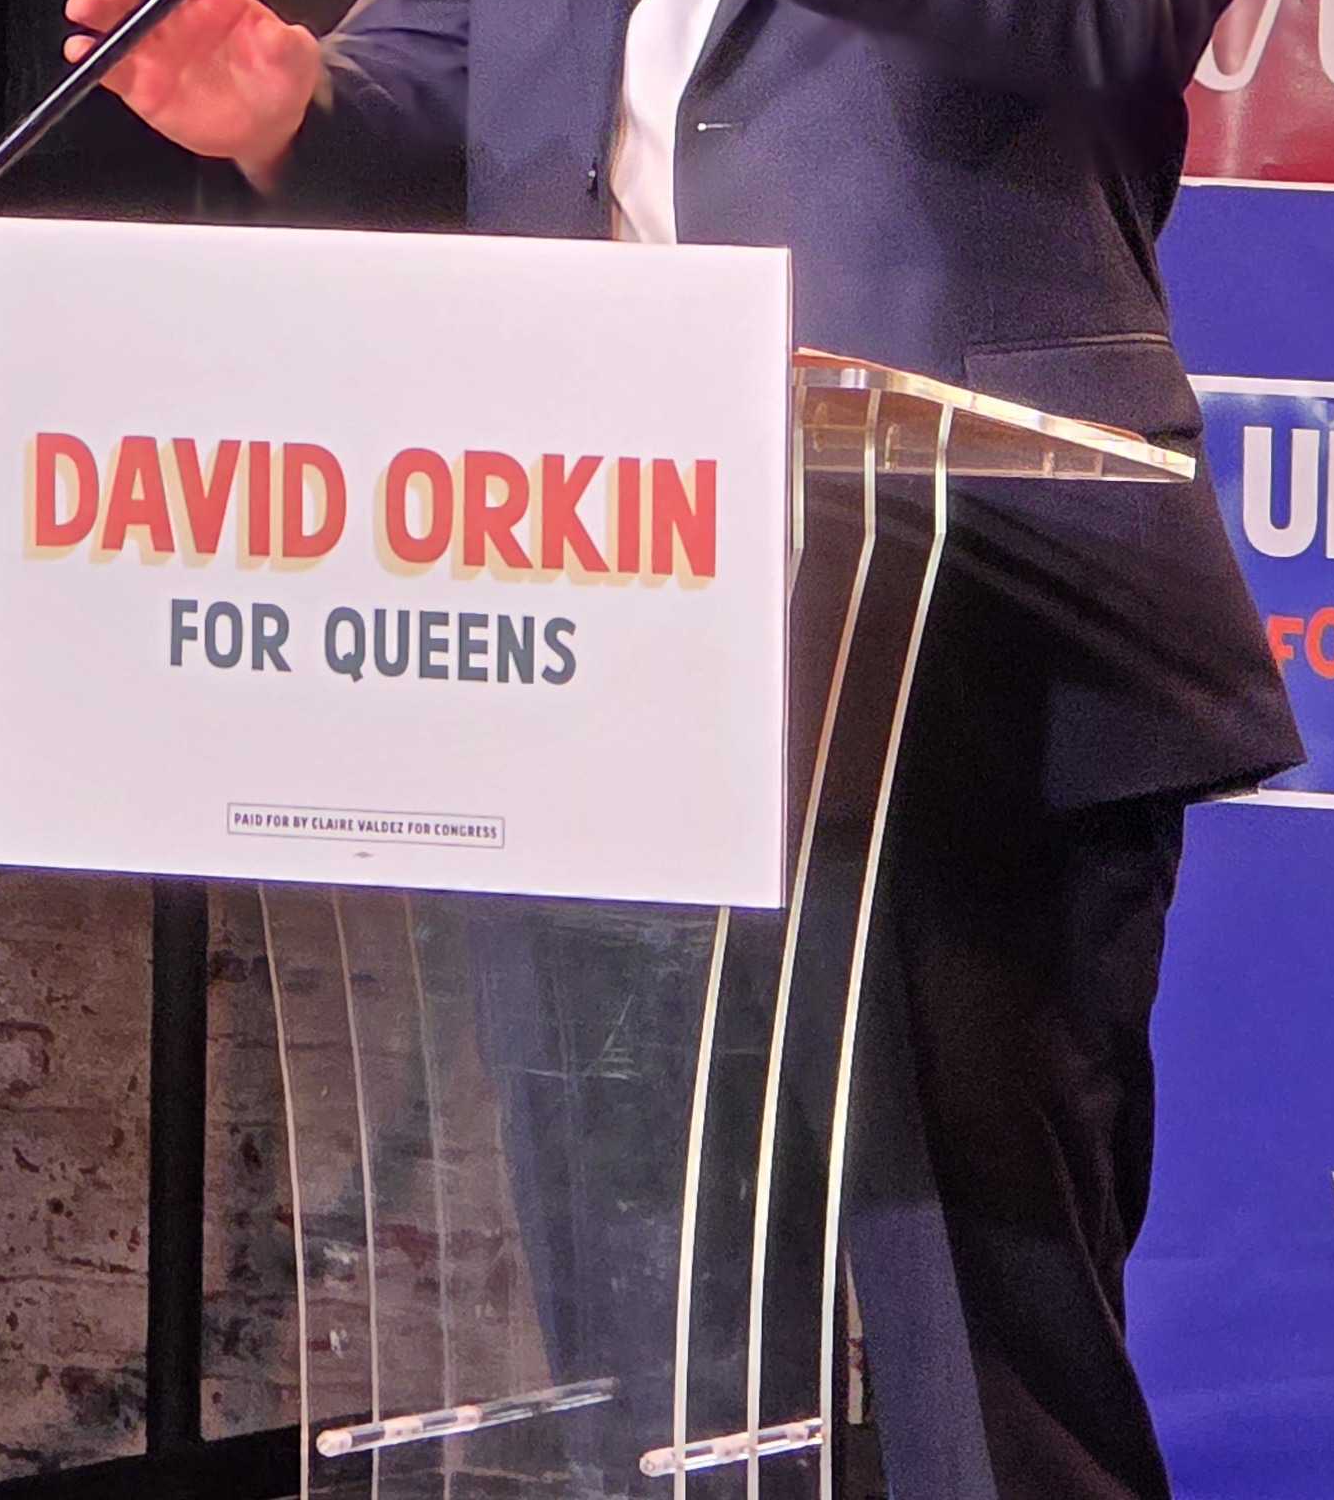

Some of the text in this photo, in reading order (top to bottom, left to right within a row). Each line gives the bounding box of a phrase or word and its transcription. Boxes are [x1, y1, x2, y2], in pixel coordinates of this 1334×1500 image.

[29, 432, 718, 581] DAVID ORKIN
[169, 598, 578, 685] FOR QUEENS
[233, 812, 498, 839] PAID FOR BY CLAIRE VALDEZ FOR CONGRESS
